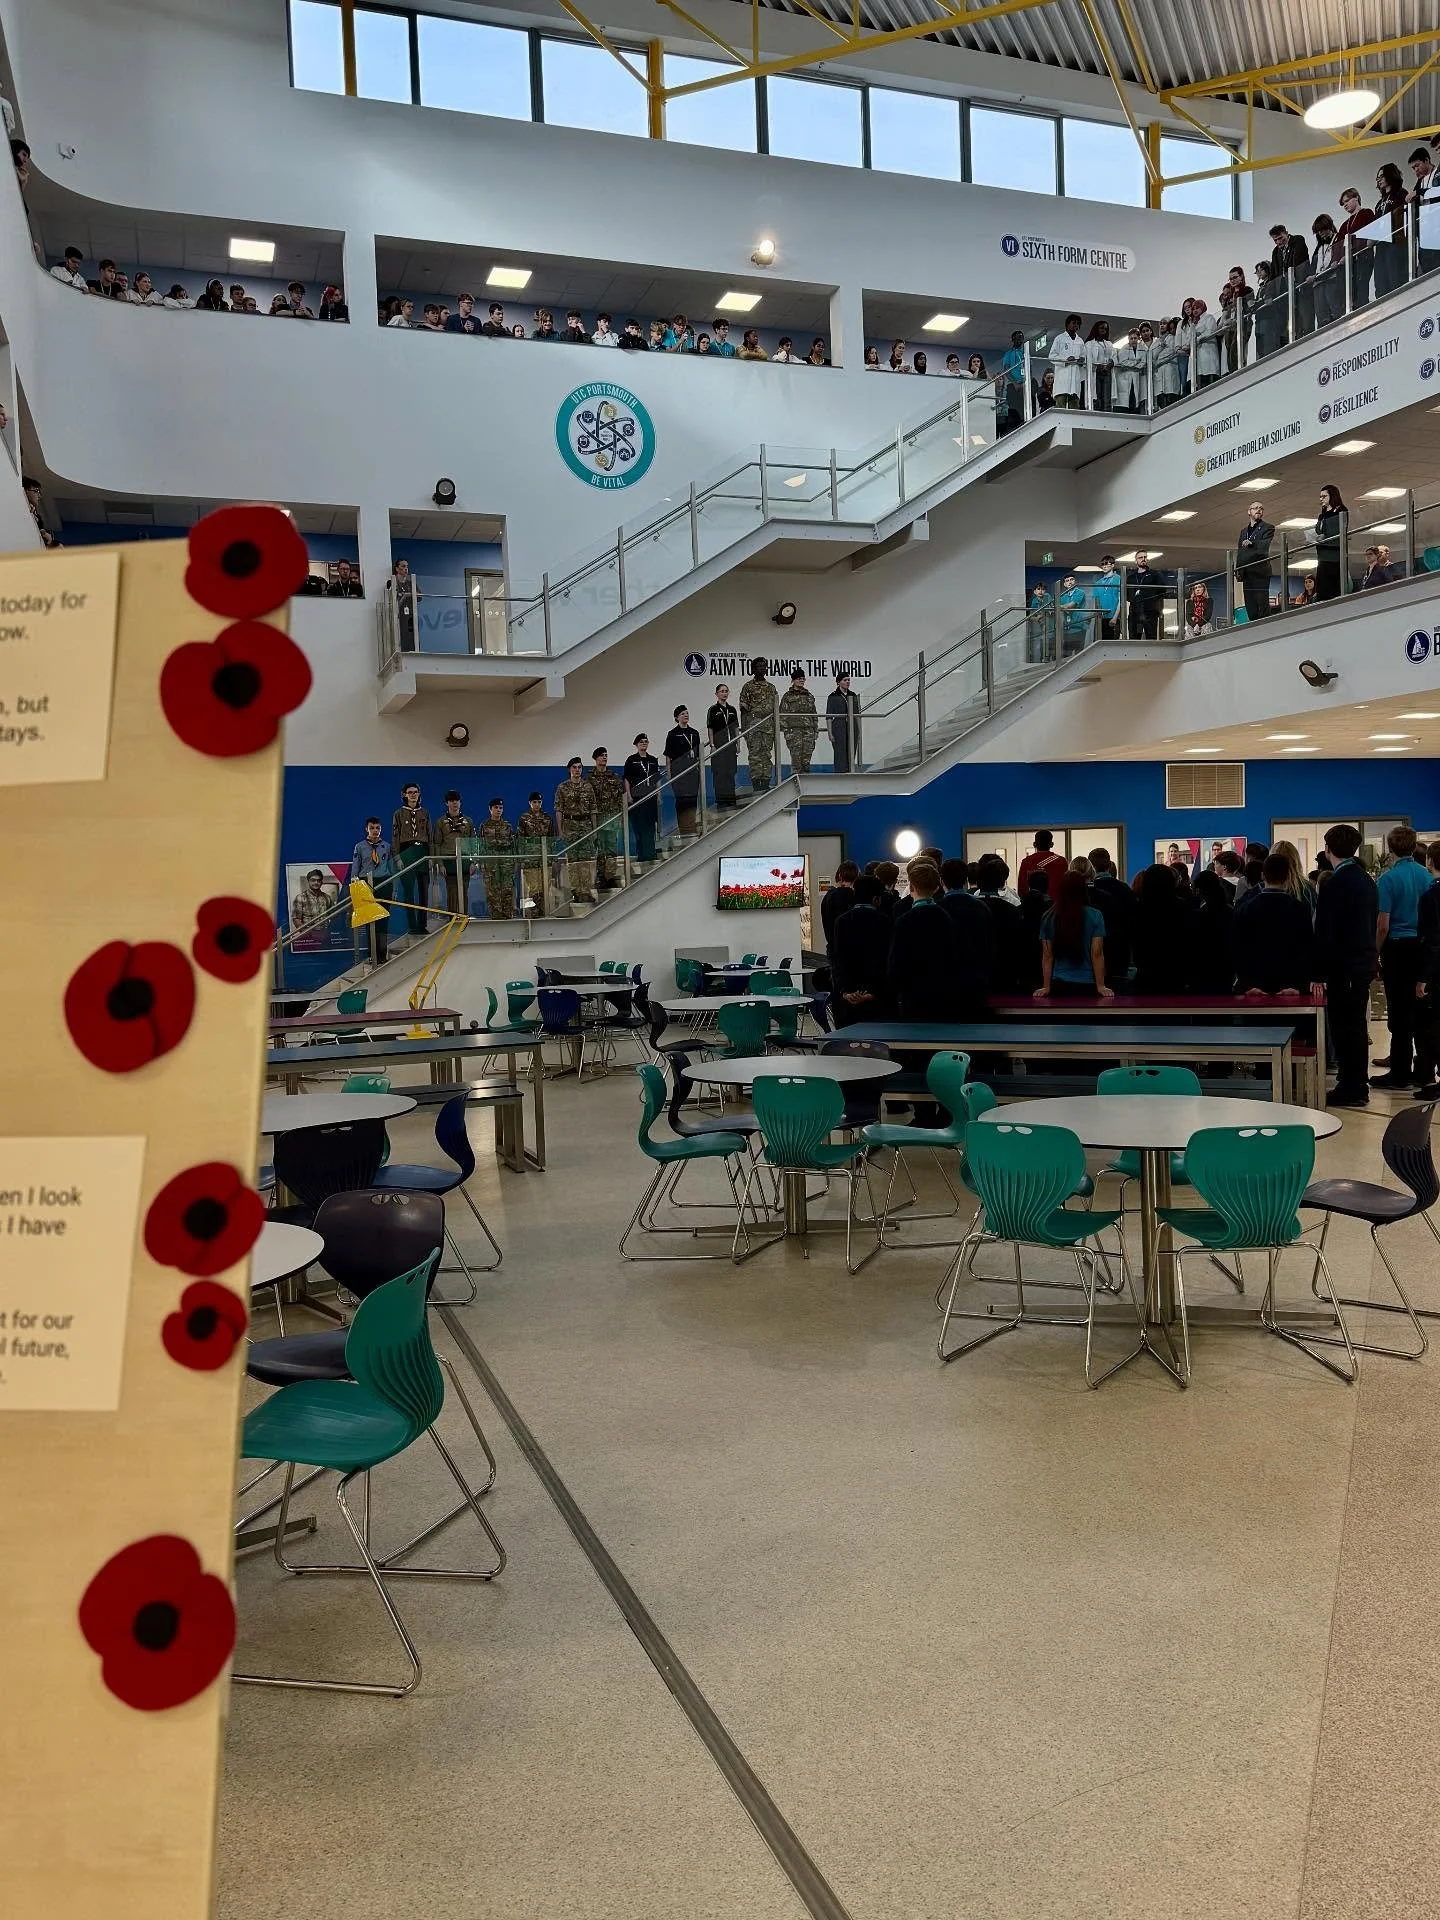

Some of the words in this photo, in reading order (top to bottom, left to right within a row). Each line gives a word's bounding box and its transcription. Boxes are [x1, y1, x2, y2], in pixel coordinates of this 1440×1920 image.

[1006, 240, 1015, 252] VI
[1022, 241, 1055, 261] SIXTH
[1058, 246, 1087, 264] FORM
[1090, 250, 1128, 269] CENTRE
[1332, 337, 1400, 381] RESPONSIBILITY
[571, 389, 588, 404] UTC
[586, 384, 638, 408] PORTSMOUTH
[1333, 386, 1379, 418] RESILIENCE
[1206, 412, 1241, 438] CURIOSITY
[1207, 449, 1237, 472] CREATIVE
[1237, 434, 1269, 459] PROBLEM
[1270, 420, 1301, 445] SOLVING
[591, 474, 601, 486] BE
[603, 476, 626, 487] VITAL
[61, 589, 87, 610] for
[709, 658, 736, 676] AIM
[766, 659, 802, 677] HANGE
[806, 660, 828, 677] THE
[831, 660, 872, 677] WORLD
[16, 694, 49, 714] but
[39, 1185, 82, 1207] look
[19, 1214, 66, 1235] have
[12, 1309, 38, 1329] for
[42, 1314, 74, 1330] our
[11, 1337, 70, 1360] future,
